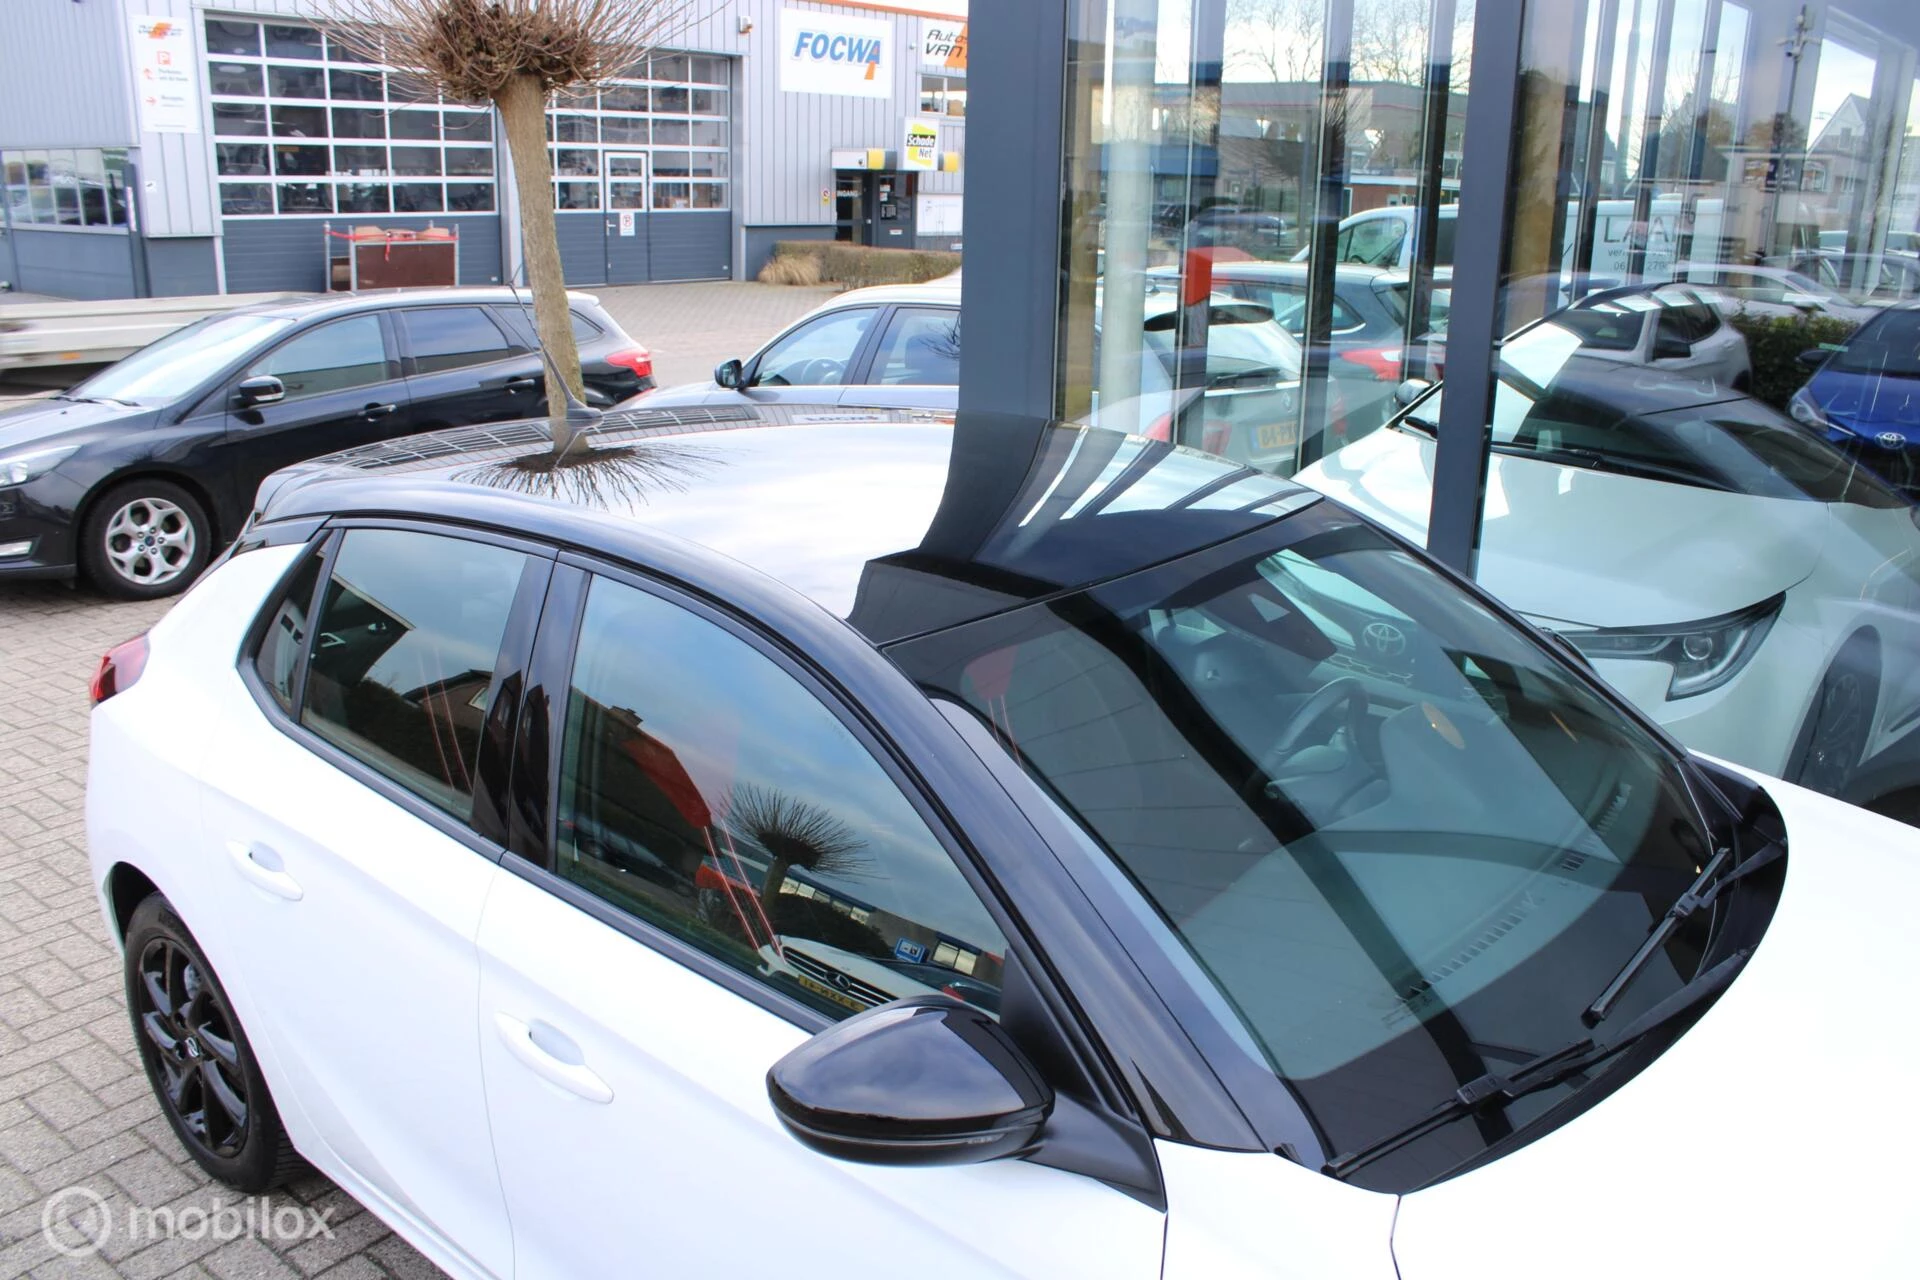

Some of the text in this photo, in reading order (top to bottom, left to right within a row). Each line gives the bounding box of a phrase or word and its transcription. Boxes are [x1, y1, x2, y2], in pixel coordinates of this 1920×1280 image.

[926, 29, 967, 44] Auto
[794, 32, 881, 65] FOCWA
[907, 134, 935, 147] Schade
[919, 148, 932, 158] Net
